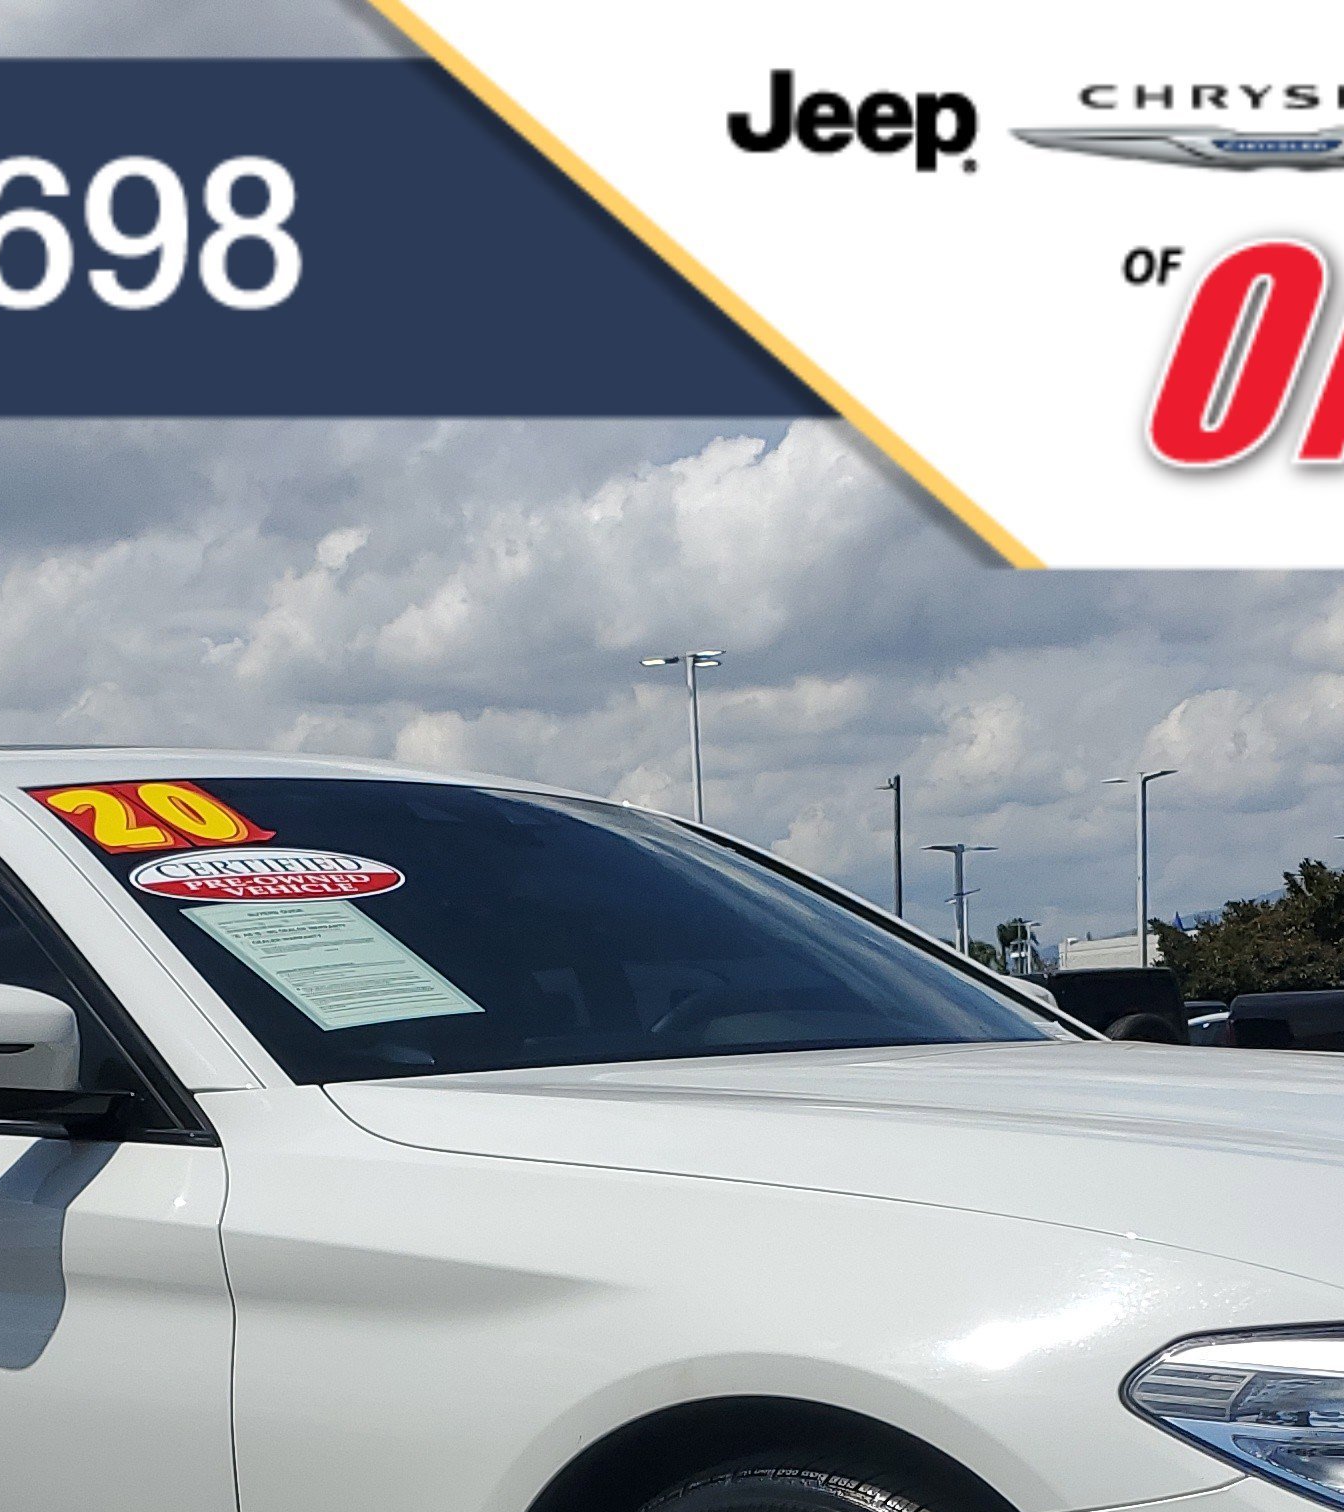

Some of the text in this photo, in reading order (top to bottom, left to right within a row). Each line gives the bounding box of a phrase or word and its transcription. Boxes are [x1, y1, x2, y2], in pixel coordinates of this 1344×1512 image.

[47, 783, 248, 848] 20
[156, 856, 362, 879] CERTIFIED
[182, 873, 371, 891] PRE-OWNED
[218, 883, 359, 896] VEHICLE
